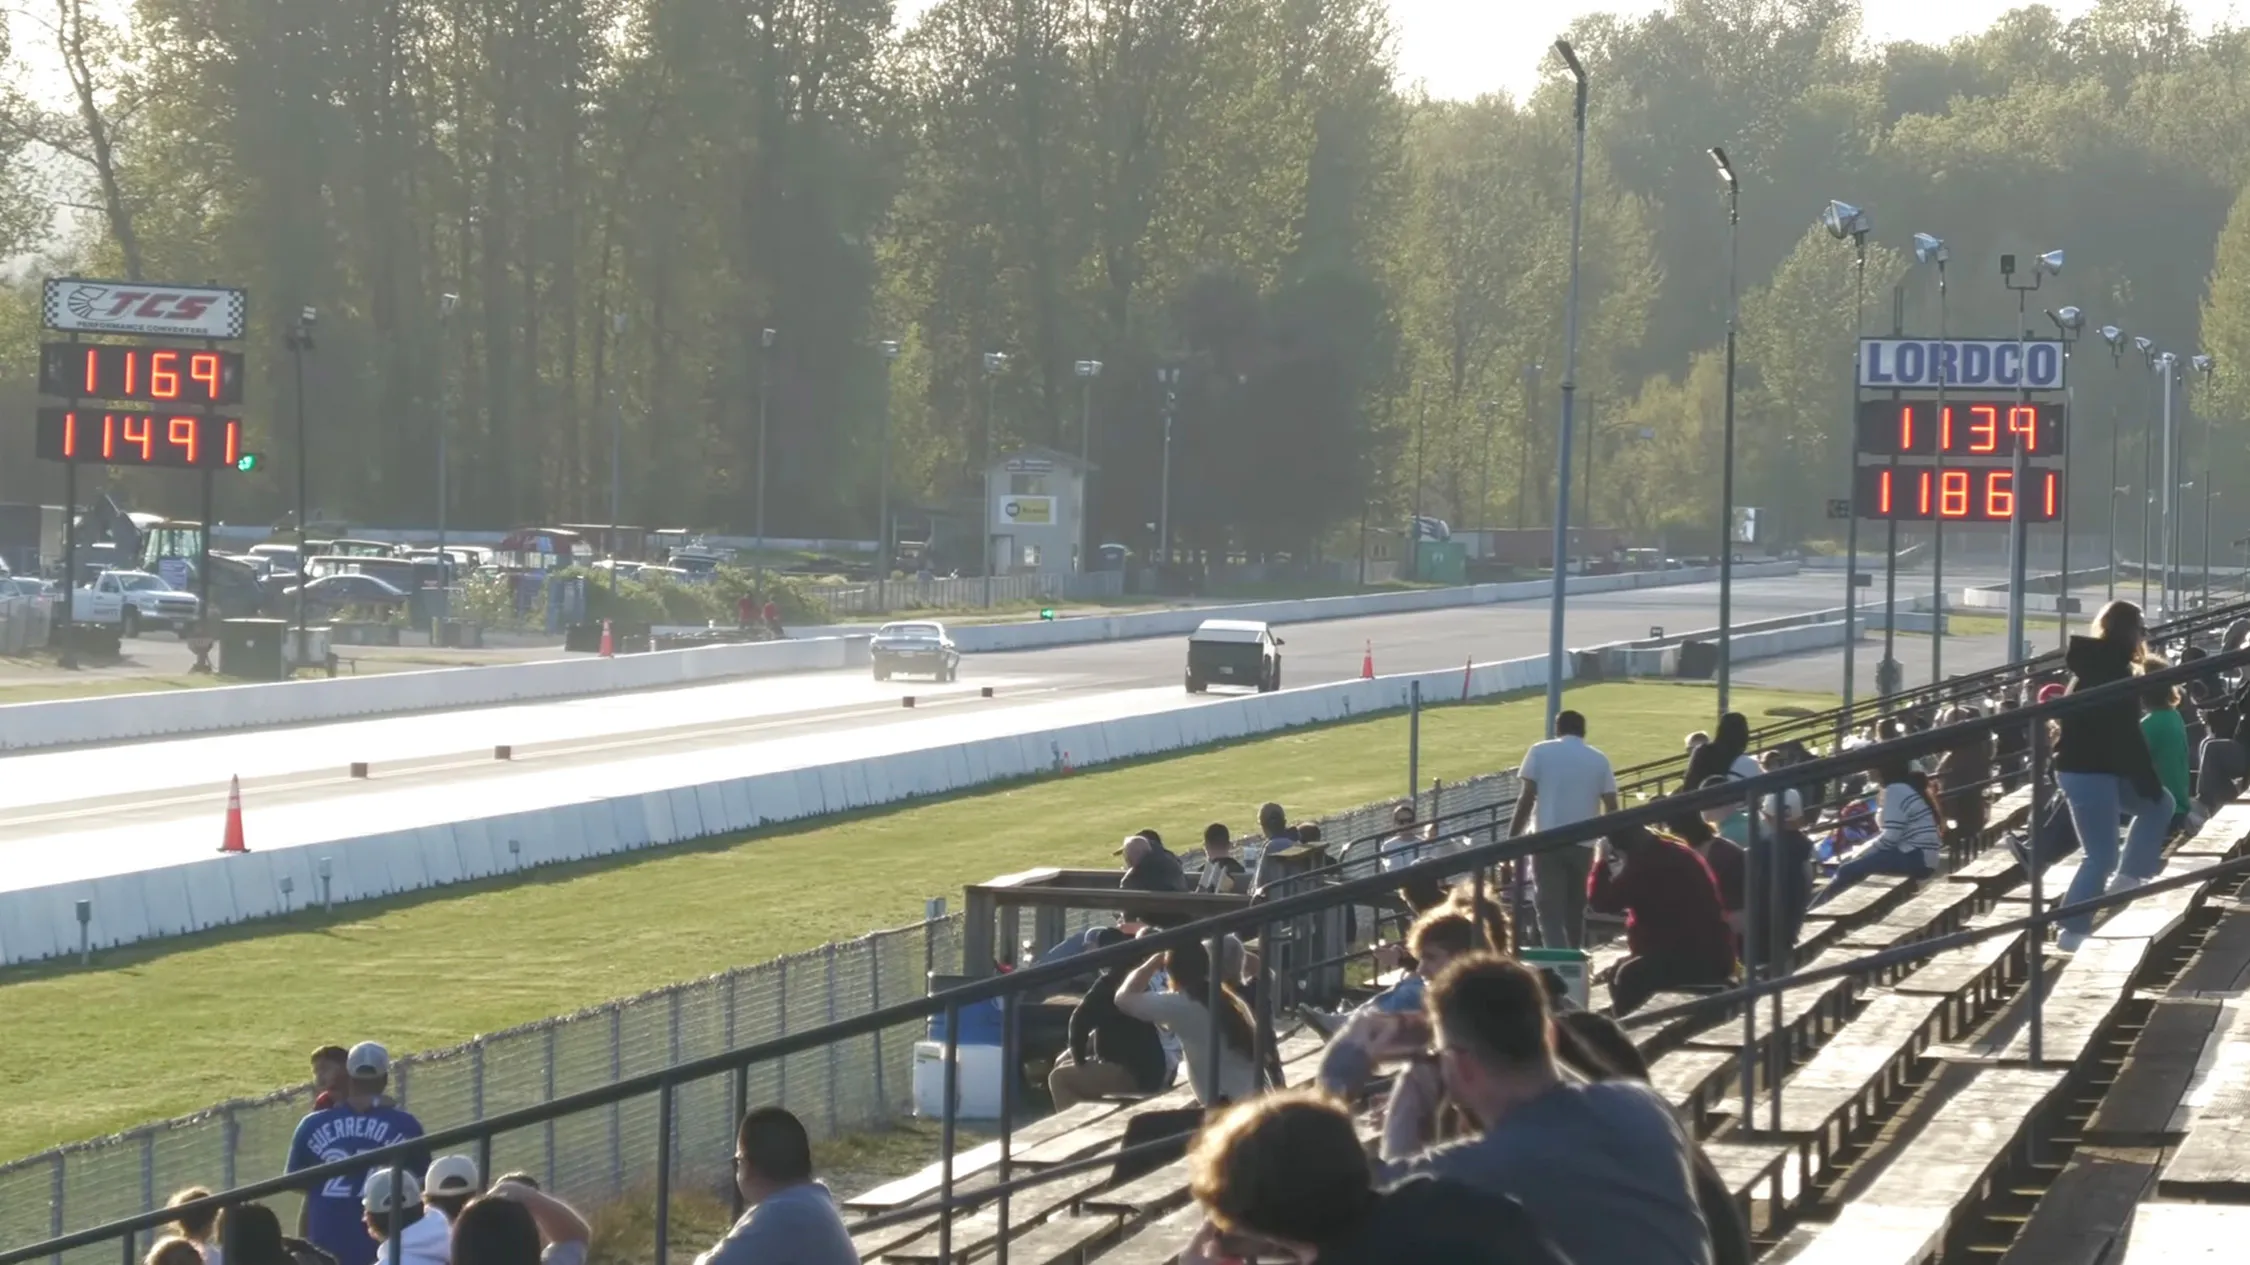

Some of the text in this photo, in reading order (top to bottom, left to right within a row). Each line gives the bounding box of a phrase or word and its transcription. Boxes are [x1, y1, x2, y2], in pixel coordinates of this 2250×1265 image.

[105, 291, 220, 321] TCS
[1867, 342, 2057, 385] LORDCO
[307, 1116, 390, 1156] GUERRERO
